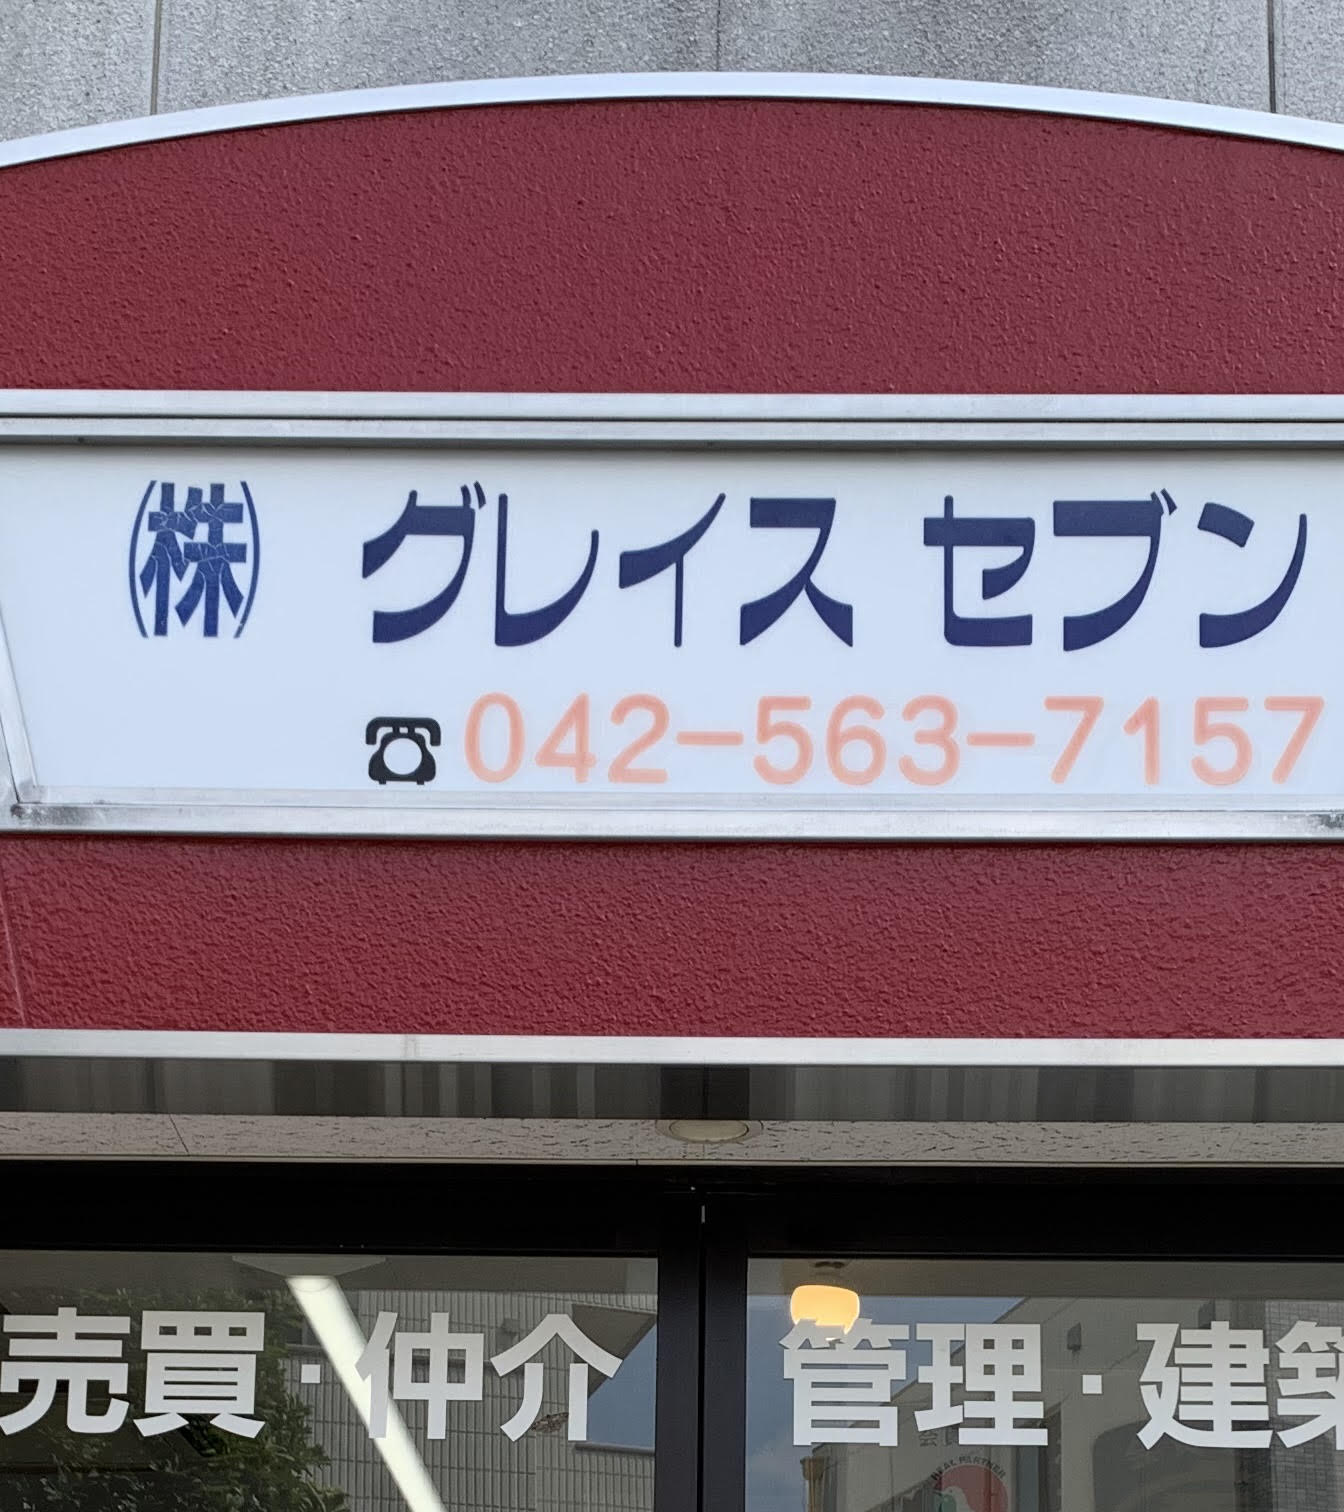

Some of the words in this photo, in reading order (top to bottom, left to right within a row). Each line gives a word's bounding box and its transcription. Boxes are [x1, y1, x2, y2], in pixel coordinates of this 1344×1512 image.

[362, 481, 856, 648] グレイス
[922, 488, 1309, 651] セブン
[462, 690, 1327, 788] 042-563-7157
